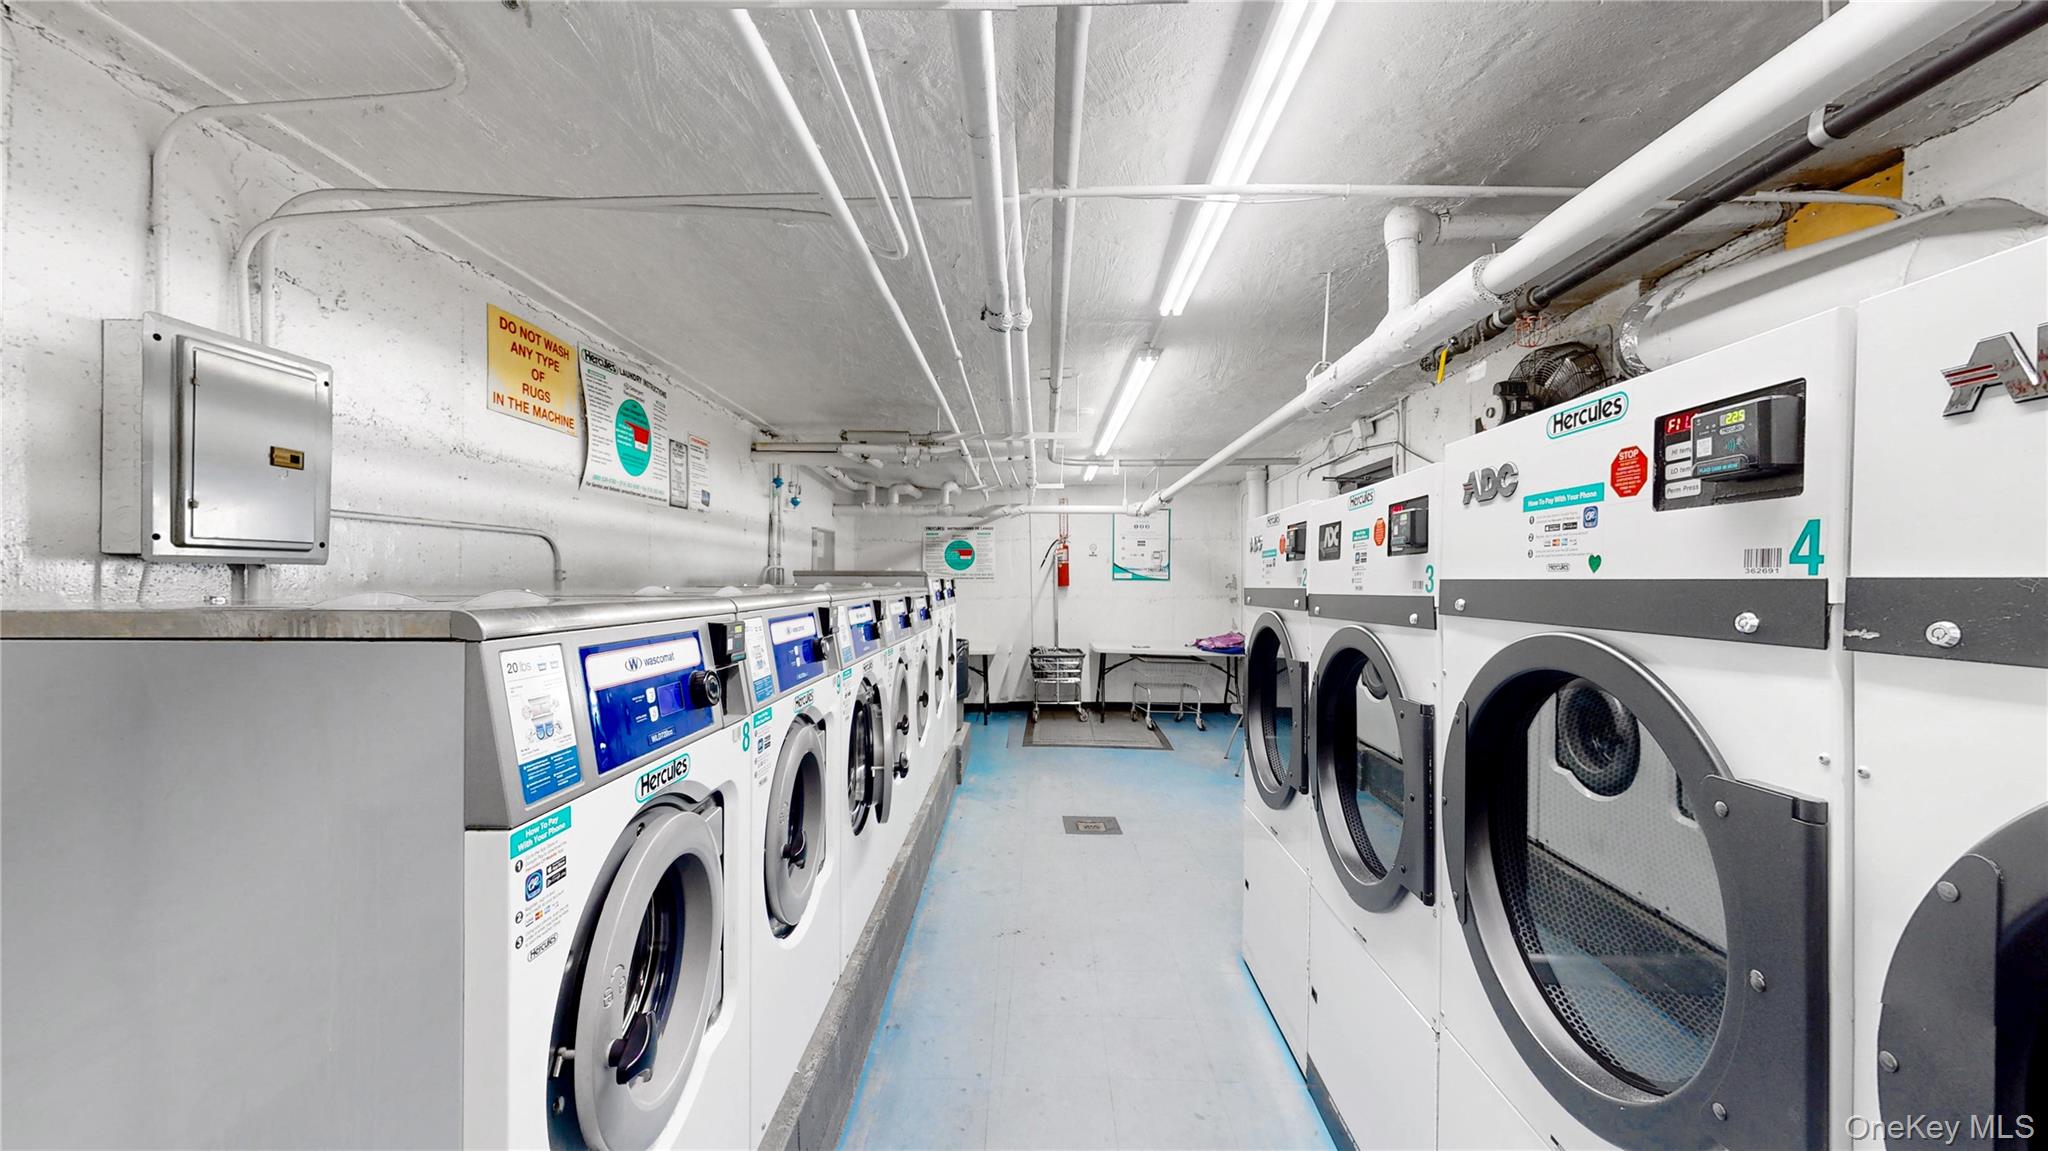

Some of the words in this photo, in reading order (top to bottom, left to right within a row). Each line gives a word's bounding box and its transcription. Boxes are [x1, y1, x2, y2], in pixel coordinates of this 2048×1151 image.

[499, 316, 516, 334] DO
[520, 326, 541, 345] NOT
[544, 337, 569, 360] WASH
[511, 341, 533, 360] ANY
[535, 351, 559, 372] TYPE
[583, 349, 616, 373] Hercules
[531, 368, 545, 382] OF
[522, 383, 551, 403] RUGS
[493, 391, 504, 406] IN
[508, 396, 529, 414] THE
[533, 405, 574, 429] MACHINE
[1553, 397, 1623, 434] Hercules
[1619, 449, 1639, 460] STOP
[1463, 461, 1519, 505] ADC
[1539, 498, 1545, 506] To
[1545, 497, 1554, 505] Pay
[1567, 493, 1579, 501] Your
[1789, 519, 1824, 575] 4
[1302, 568, 1307, 587] 2
[1425, 564, 1434, 593] 3
[507, 662, 518, 674] 20
[644, 652, 674, 668] wascomat
[743, 721, 750, 752] 8
[641, 759, 687, 796] Hercules
[518, 839, 534, 852] With
[534, 832, 548, 843] Your
[548, 823, 566, 837] Phone
[525, 826, 541, 838] How
[541, 822, 548, 830] To
[548, 817, 559, 827] Pay
[530, 936, 556, 960] Hercules
